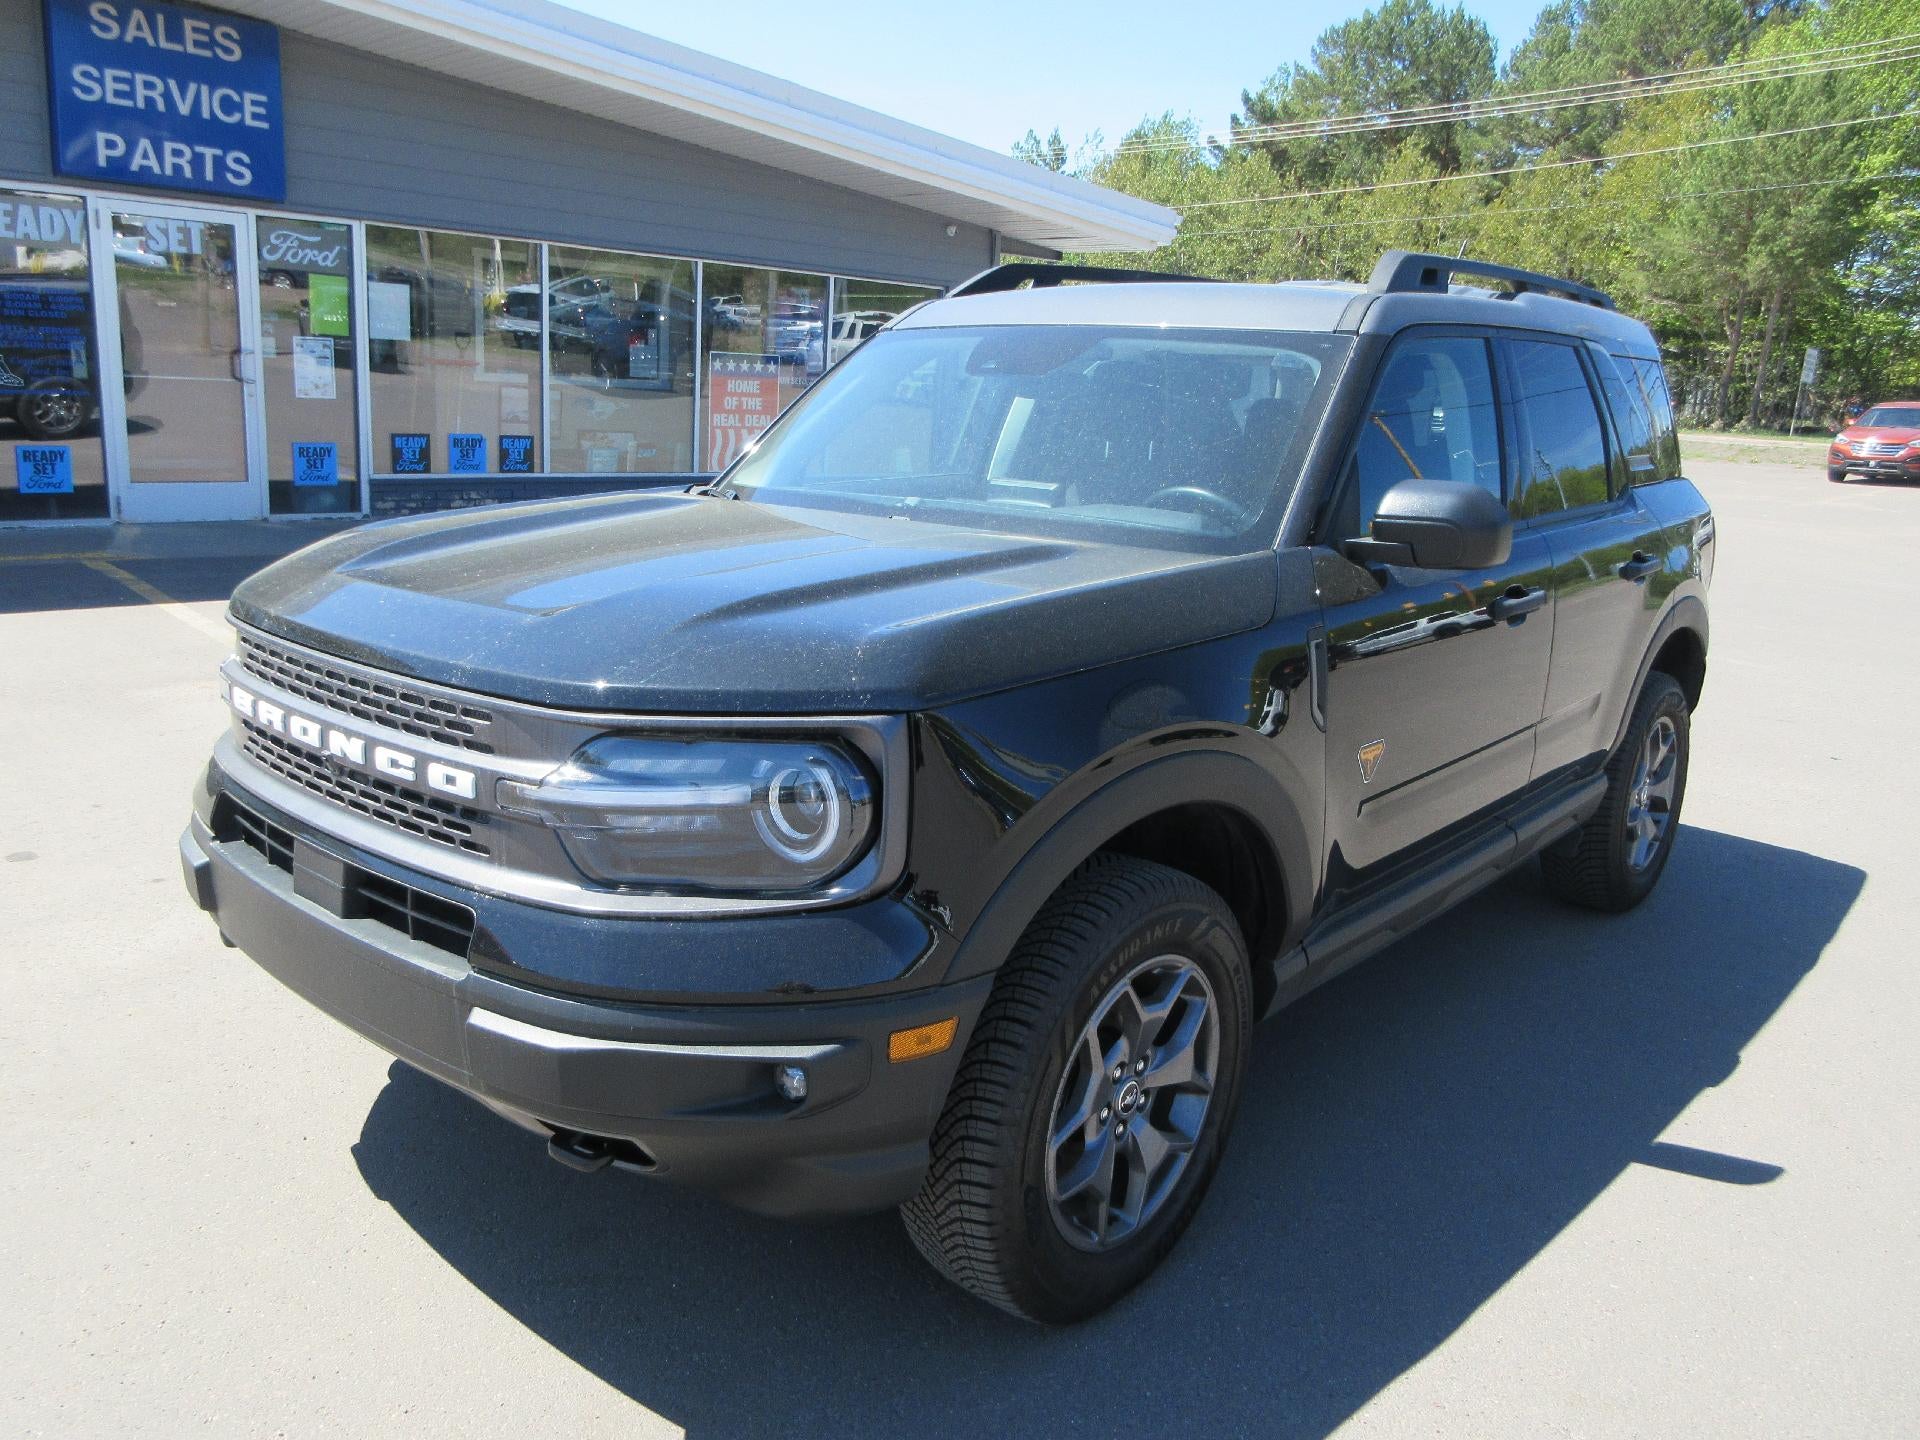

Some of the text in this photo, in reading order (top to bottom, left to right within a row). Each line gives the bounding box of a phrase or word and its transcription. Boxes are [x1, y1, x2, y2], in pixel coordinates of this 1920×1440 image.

[88, 2, 243, 63] SALES
[71, 63, 270, 130] SERVICE
[96, 130, 253, 187] PARTS
[0, 202, 340, 267] EADY SET Ford
[727, 379, 760, 394] HOME
[724, 396, 763, 411] OF THE
[713, 413, 741, 427] REAL
[395, 436, 427, 449] READY
[453, 438, 483, 449] READY
[502, 438, 532, 449] READY
[22, 449, 65, 463] READY
[298, 446, 332, 459] READY
[402, 448, 420, 460] SET
[459, 448, 476, 460] SET
[508, 449, 525, 460] SET
[33, 462, 57, 475] SET
[305, 457, 325, 470] SET
[396, 459, 426, 471] Ford
[454, 459, 482, 471] Ford
[502, 459, 530, 471] Ford
[299, 469, 331, 481] Ford
[25, 475, 65, 489] Ford
[232, 685, 477, 799] BRONCO
